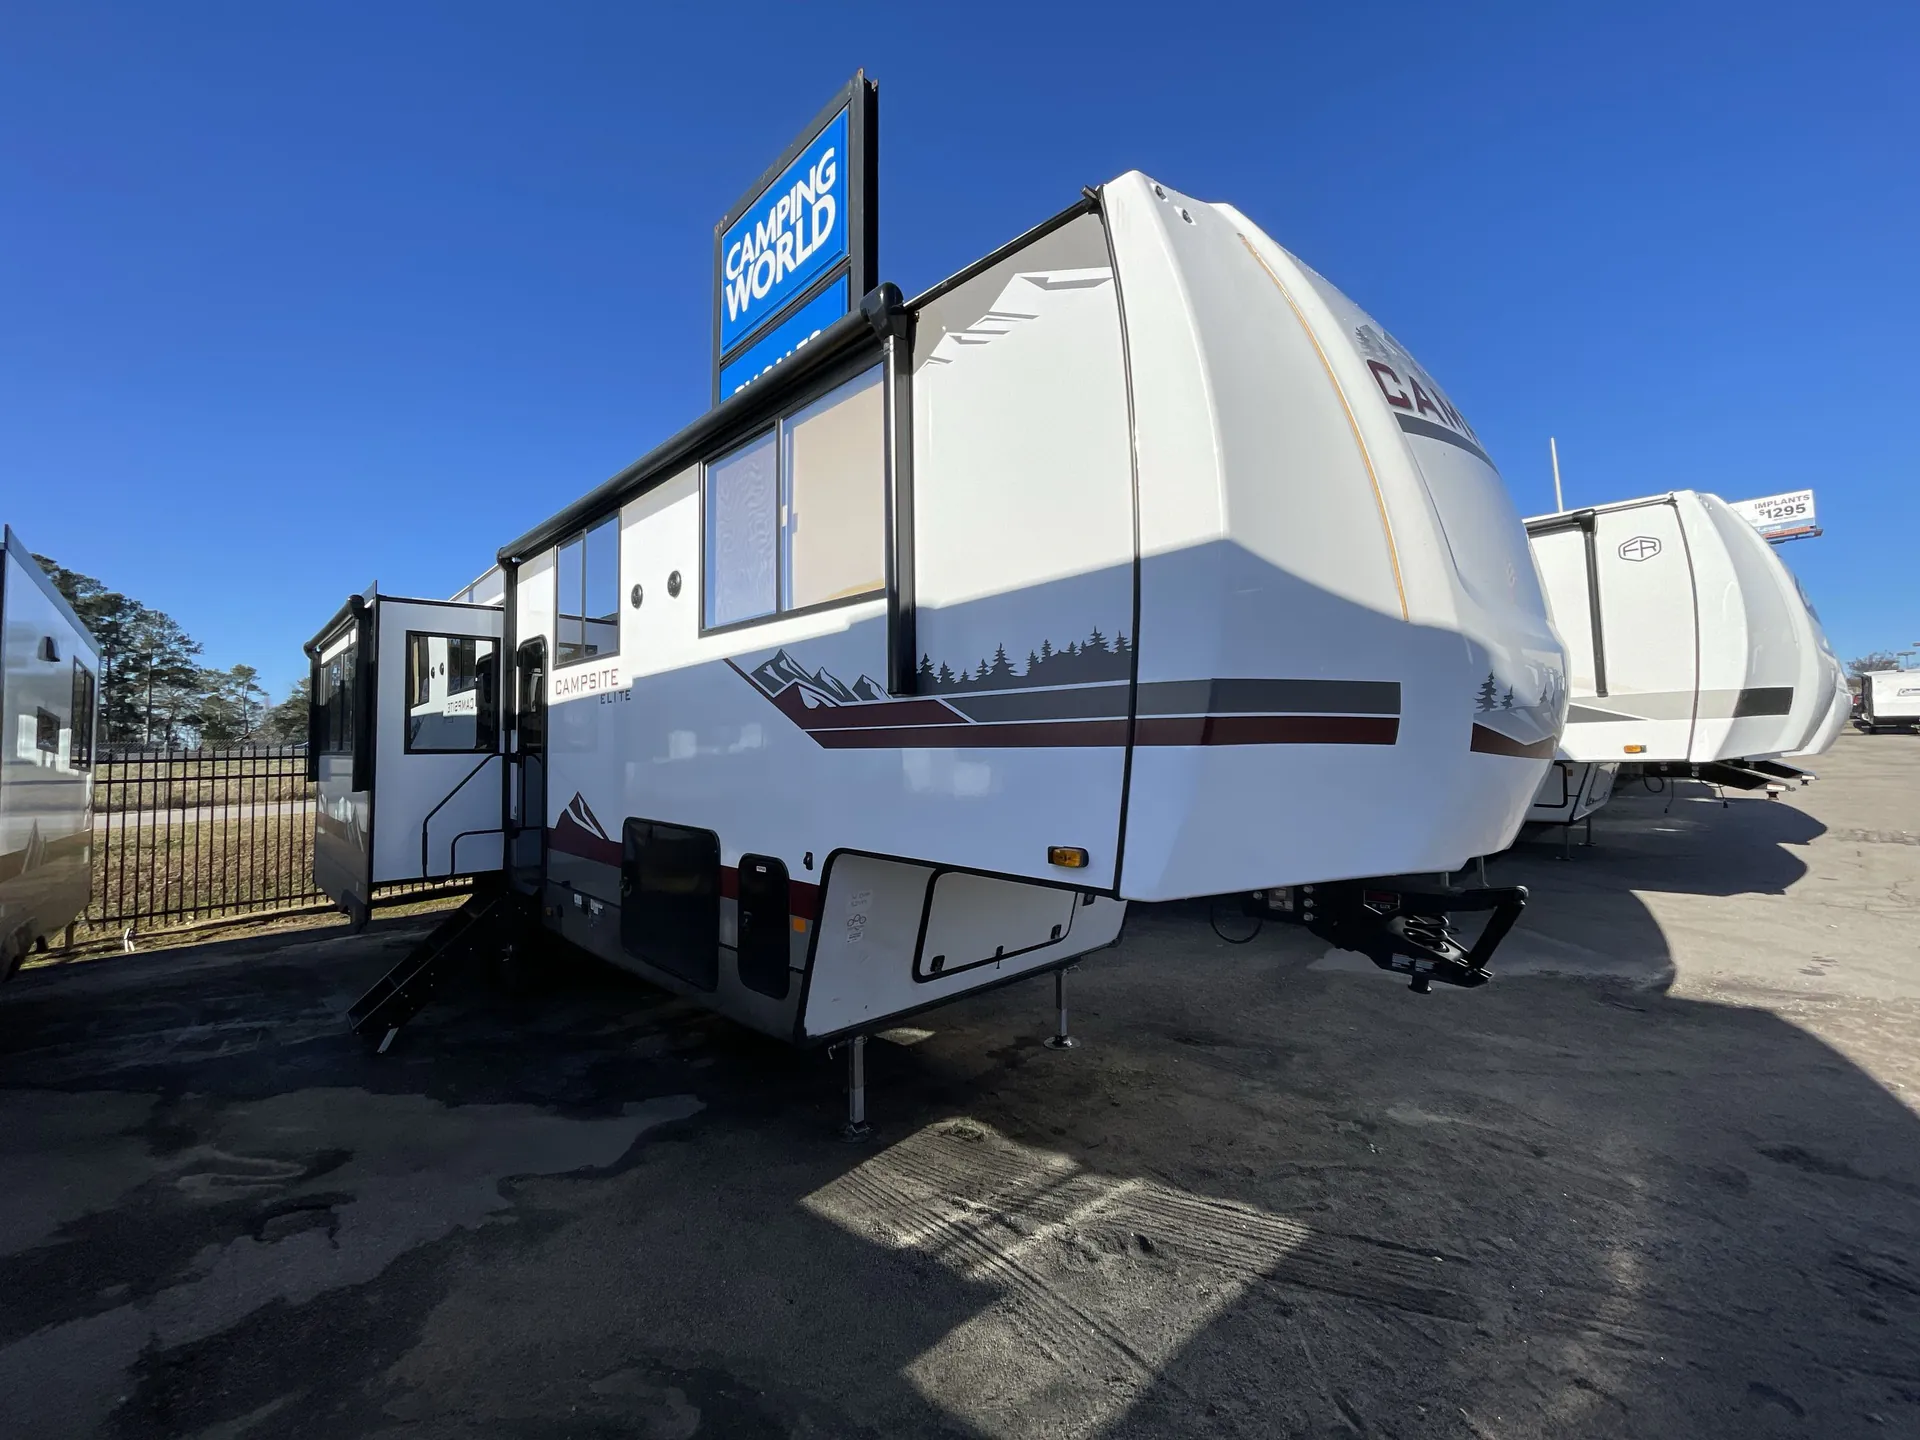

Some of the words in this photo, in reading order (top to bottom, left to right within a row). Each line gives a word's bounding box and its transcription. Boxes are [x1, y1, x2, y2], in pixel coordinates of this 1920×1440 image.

[726, 146, 836, 281] CAMPING
[726, 194, 836, 322] WORLD
[1754, 494, 1810, 510] IMPLANTS
[1758, 503, 1807, 519] $1295
[555, 668, 619, 695] CAMPSITE
[600, 689, 631, 705] ELITE
